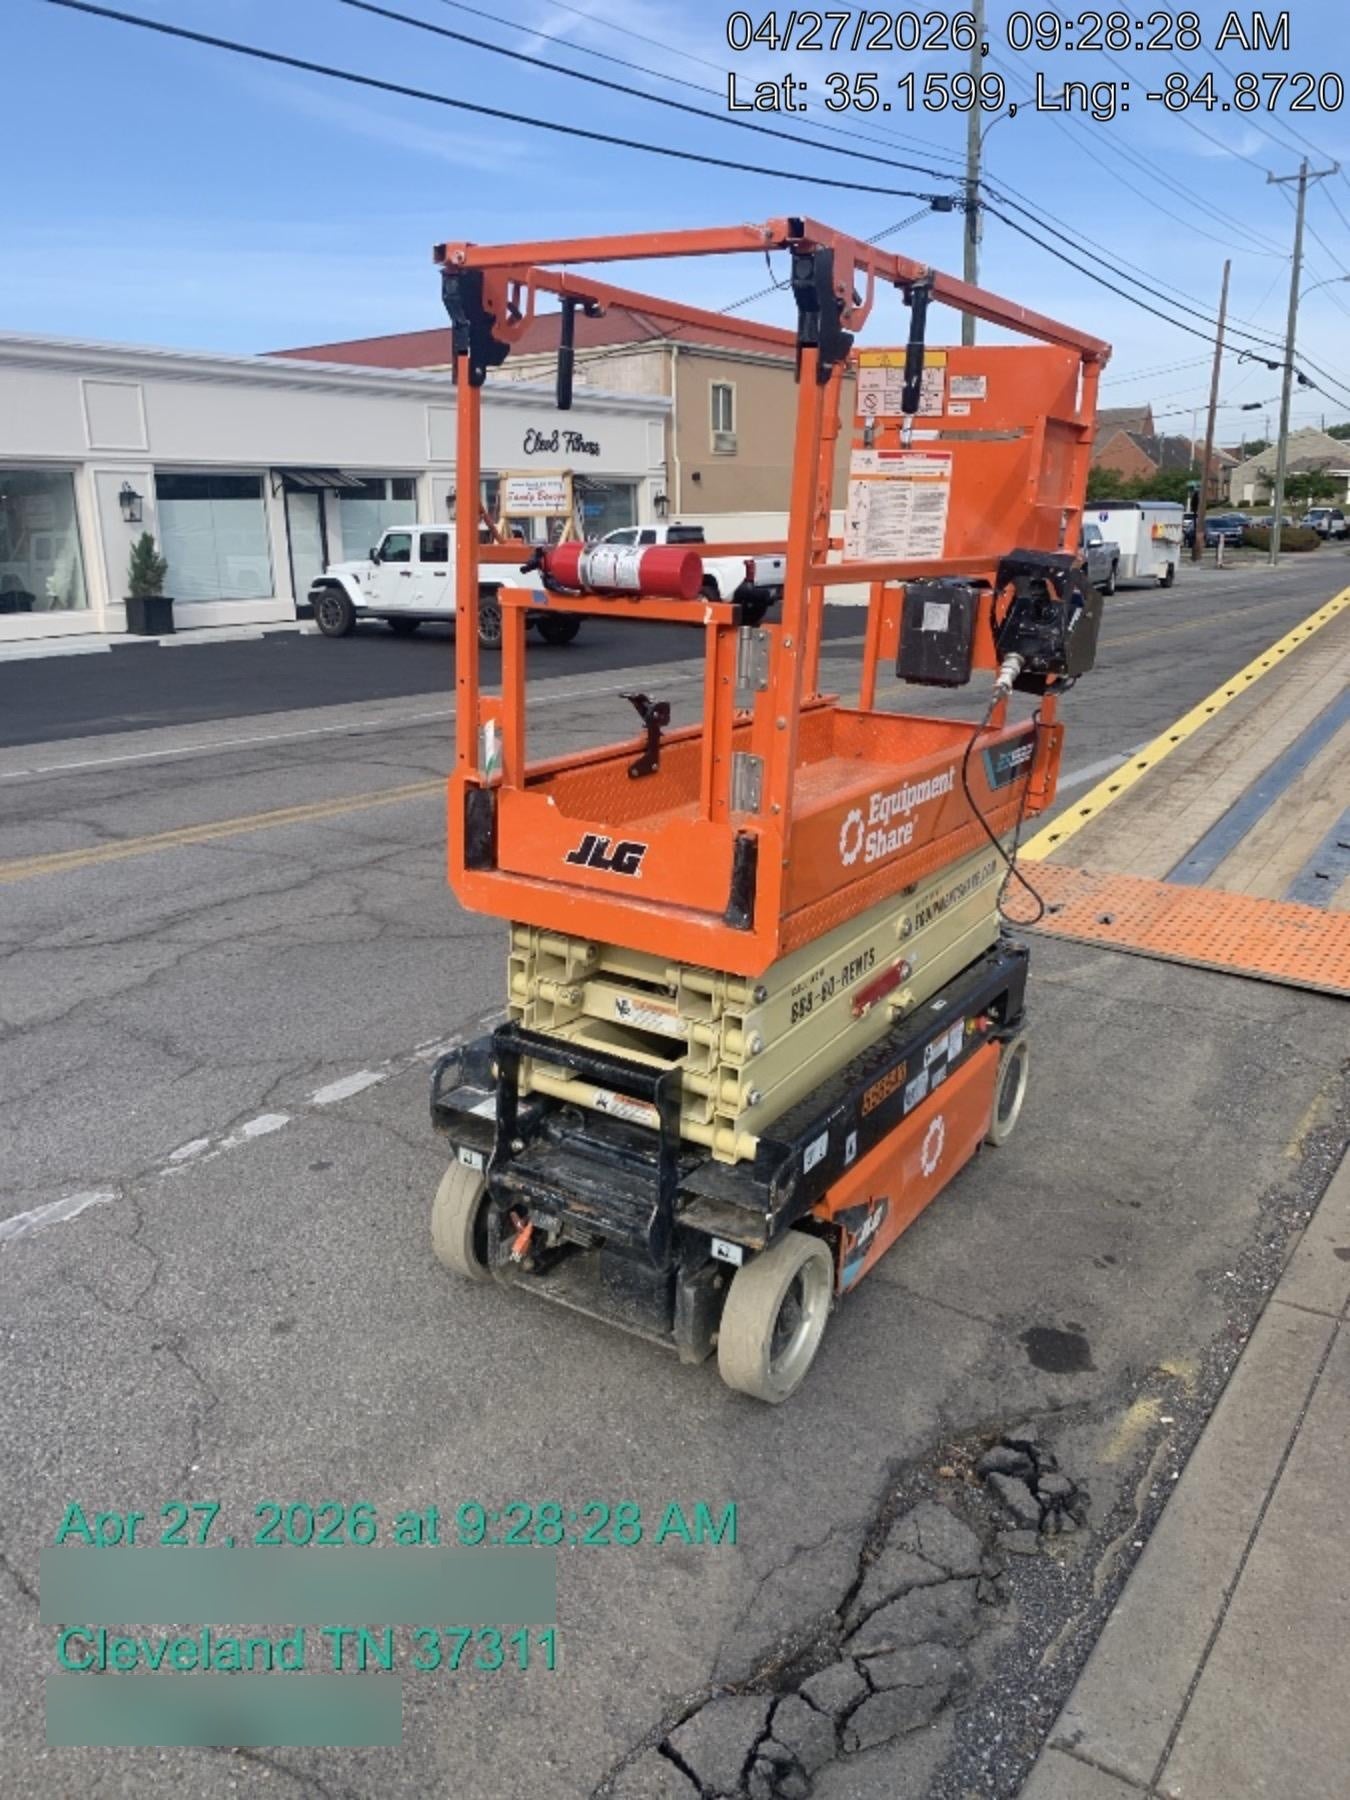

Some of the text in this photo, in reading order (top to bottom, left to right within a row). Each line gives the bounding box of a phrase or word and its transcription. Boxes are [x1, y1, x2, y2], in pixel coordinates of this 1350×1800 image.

[562, 431, 600, 457] Fitness
[868, 766, 955, 826] Equipment
[565, 832, 648, 876] JLG
[864, 821, 914, 863] Share
